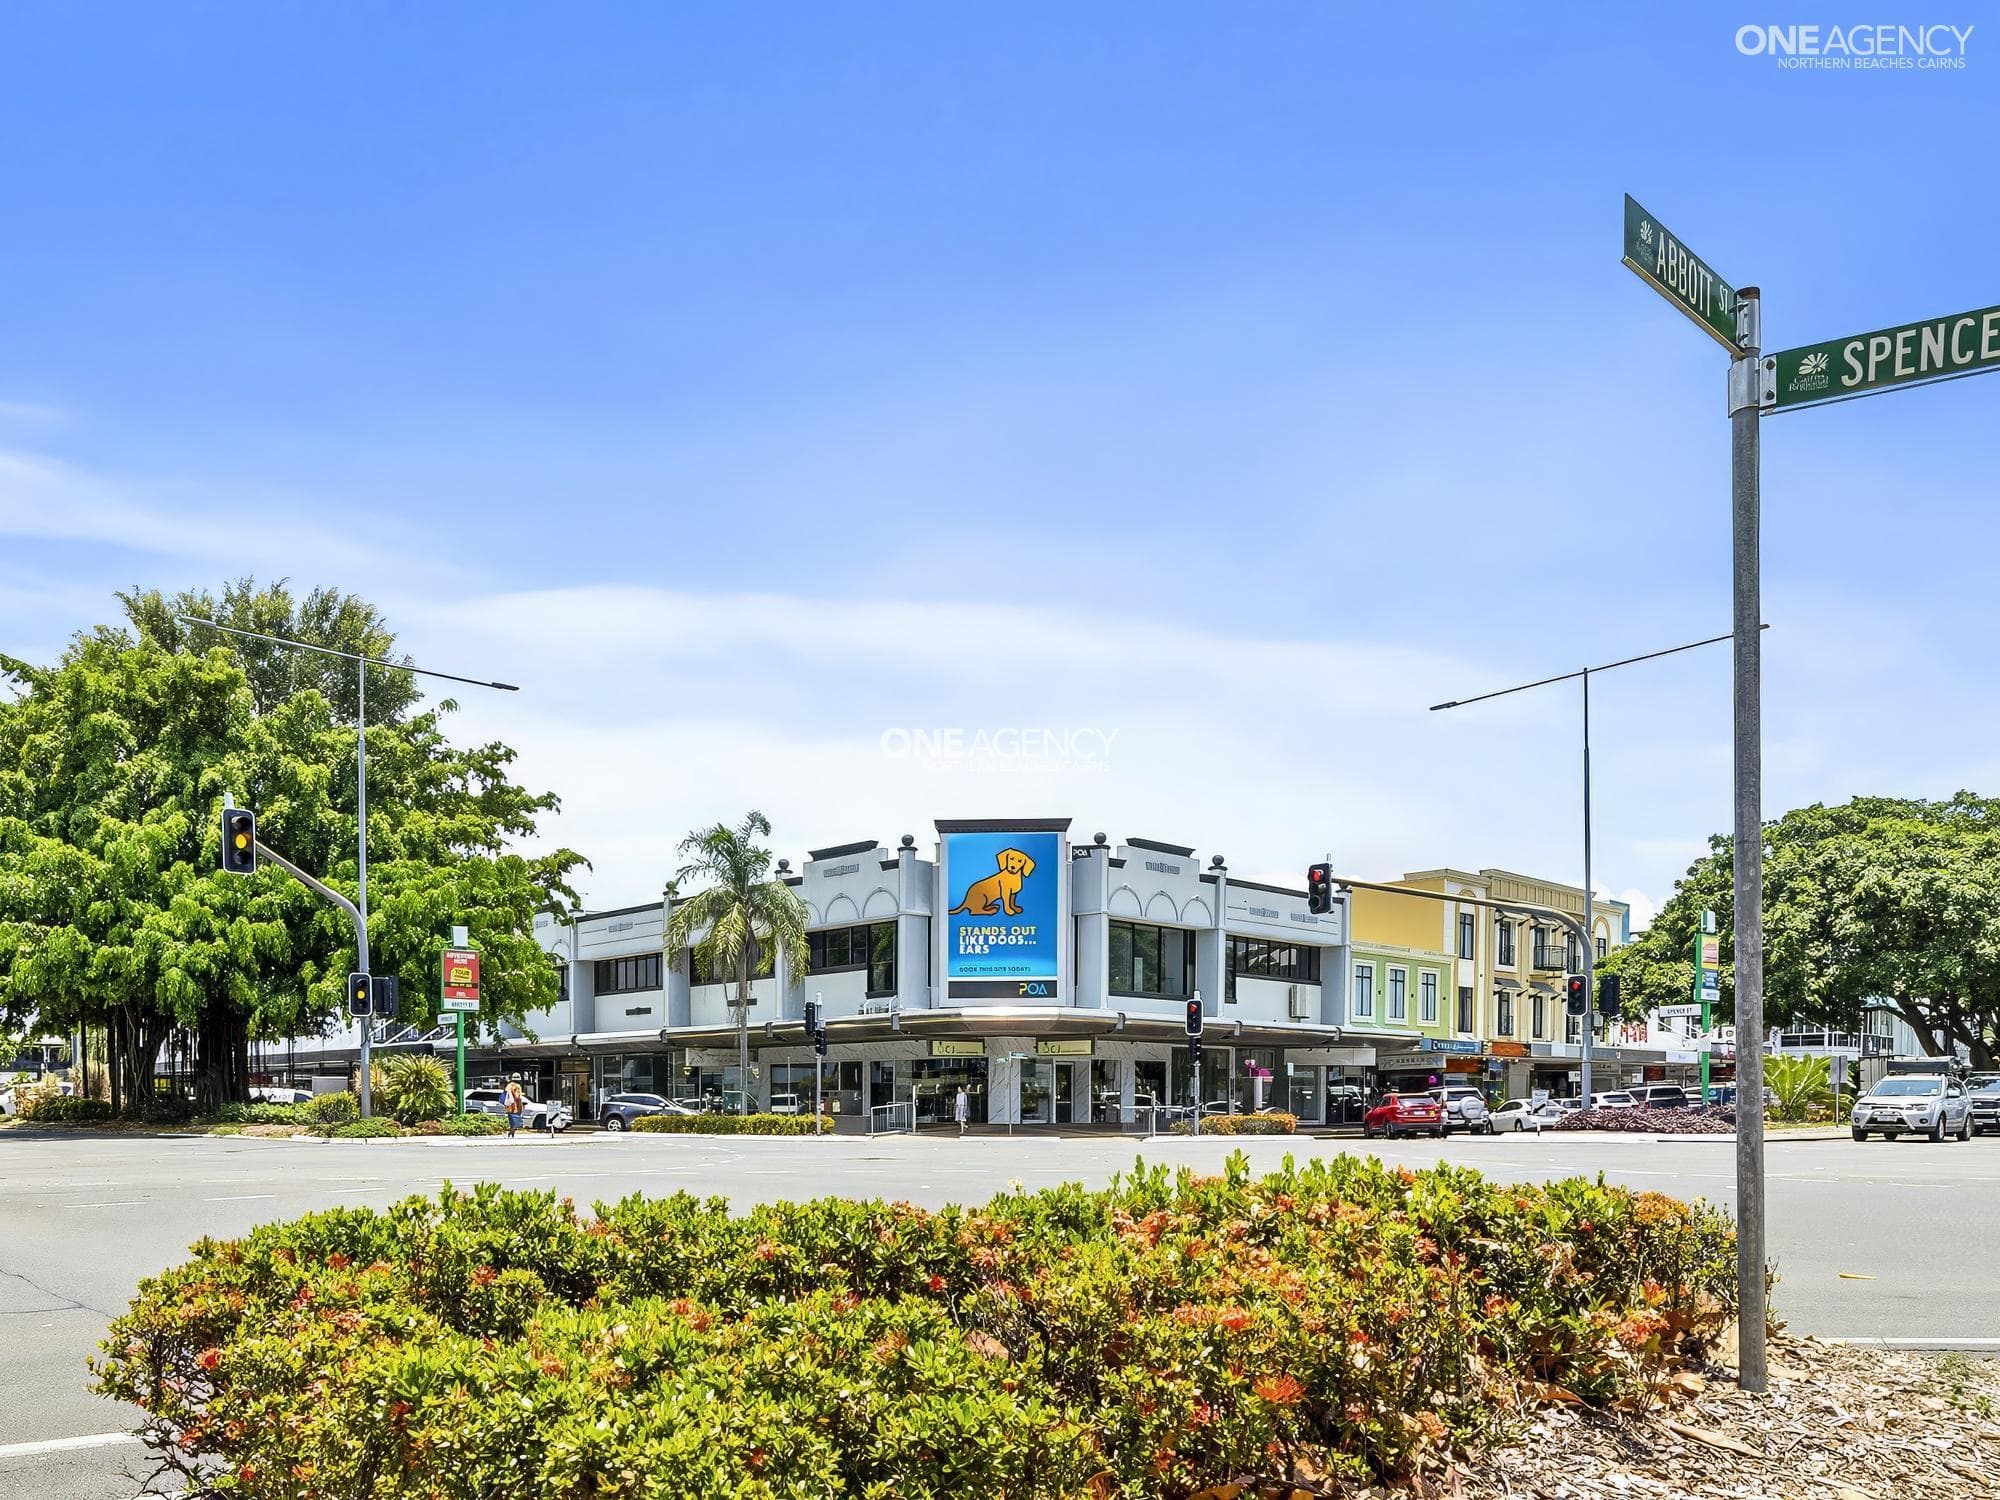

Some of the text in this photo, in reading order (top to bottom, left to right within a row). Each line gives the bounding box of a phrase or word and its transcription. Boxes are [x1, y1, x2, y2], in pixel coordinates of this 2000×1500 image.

[1656, 231, 1713, 318] ABBOTT
[1718, 284, 1728, 315] ST
[1841, 311, 2000, 388] SPENCE
[959, 926, 1037, 936] STANDS OUT
[959, 935, 1037, 945] LIKE DOGS...
[959, 945, 990, 954] EARS
[1019, 982, 1048, 995] POA
